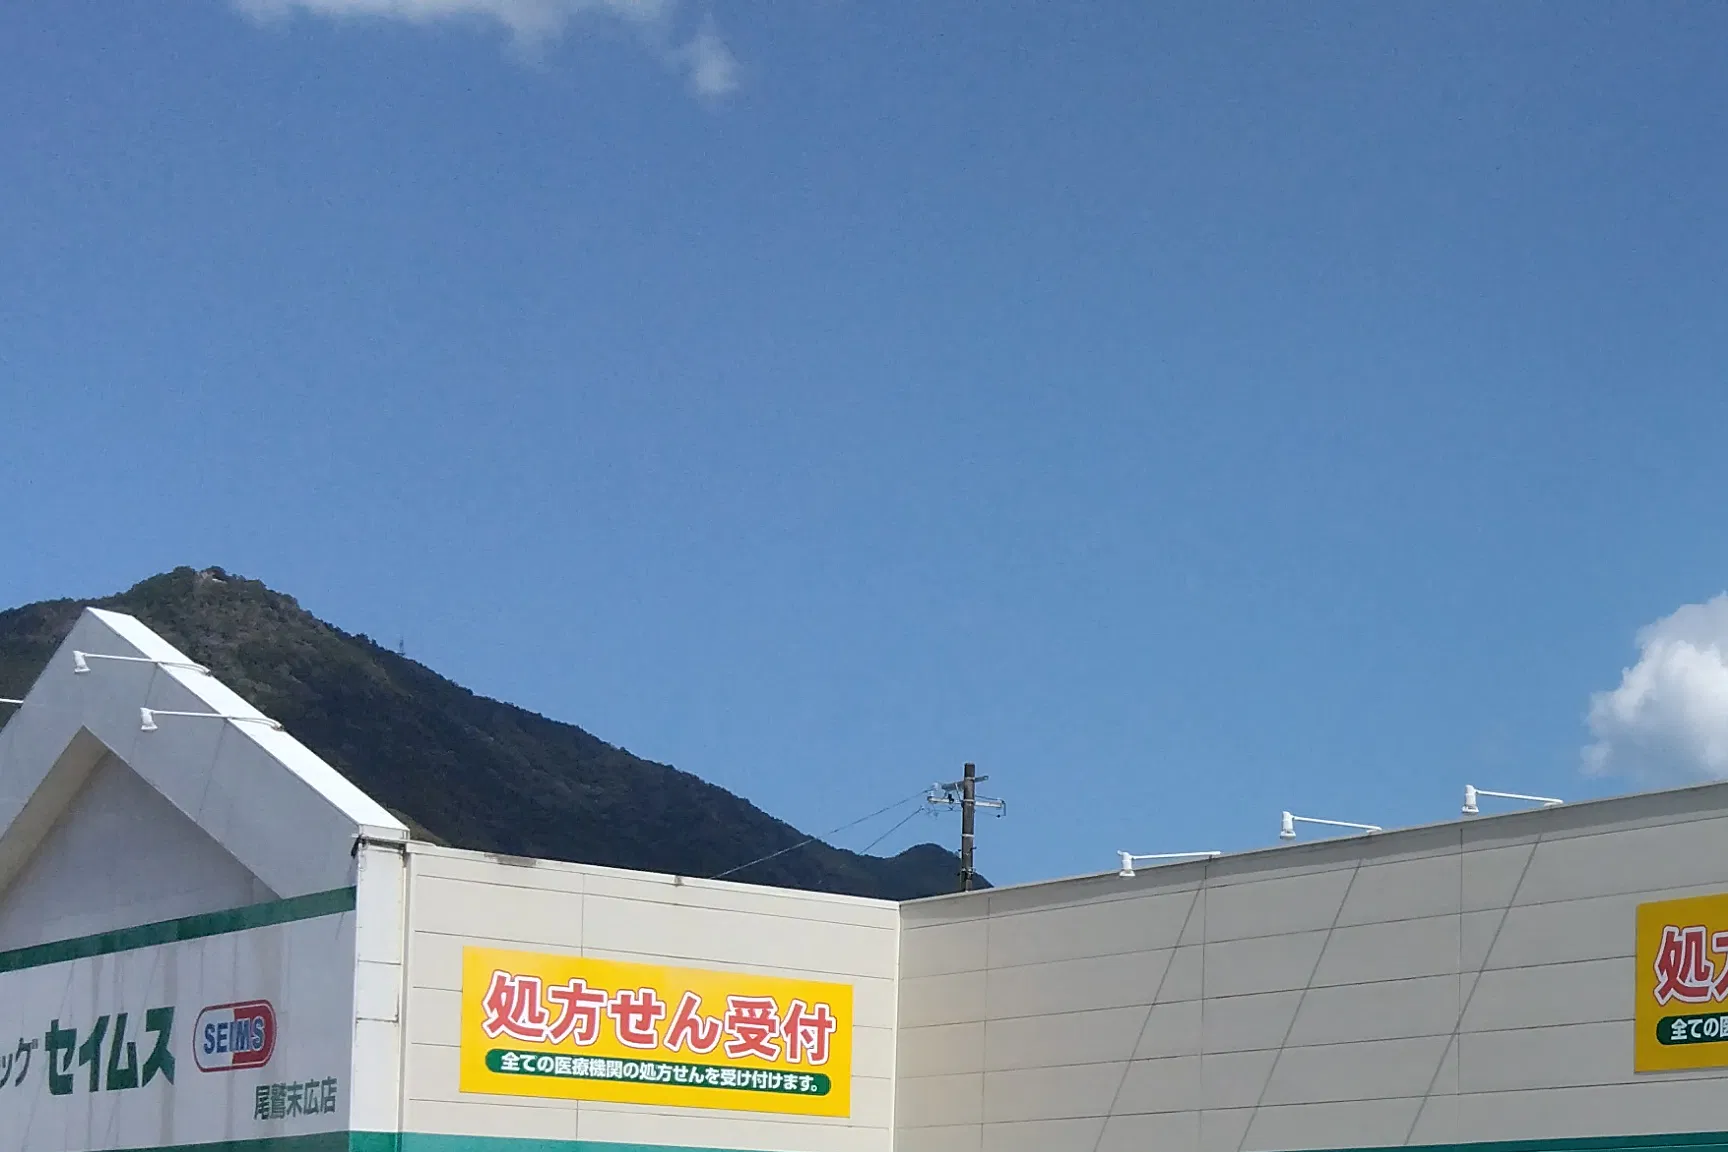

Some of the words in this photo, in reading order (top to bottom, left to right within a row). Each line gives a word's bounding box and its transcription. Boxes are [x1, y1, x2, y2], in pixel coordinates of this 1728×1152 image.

[204, 1016, 265, 1055] SEIMS
[482, 970, 836, 1065] 処方せん受付
[45, 1006, 175, 1095] セイムス
[500, 1052, 818, 1092] 全ての医療機関の処方せんを受け付けます。
[254, 1076, 337, 1120] 尾鷲末広店
